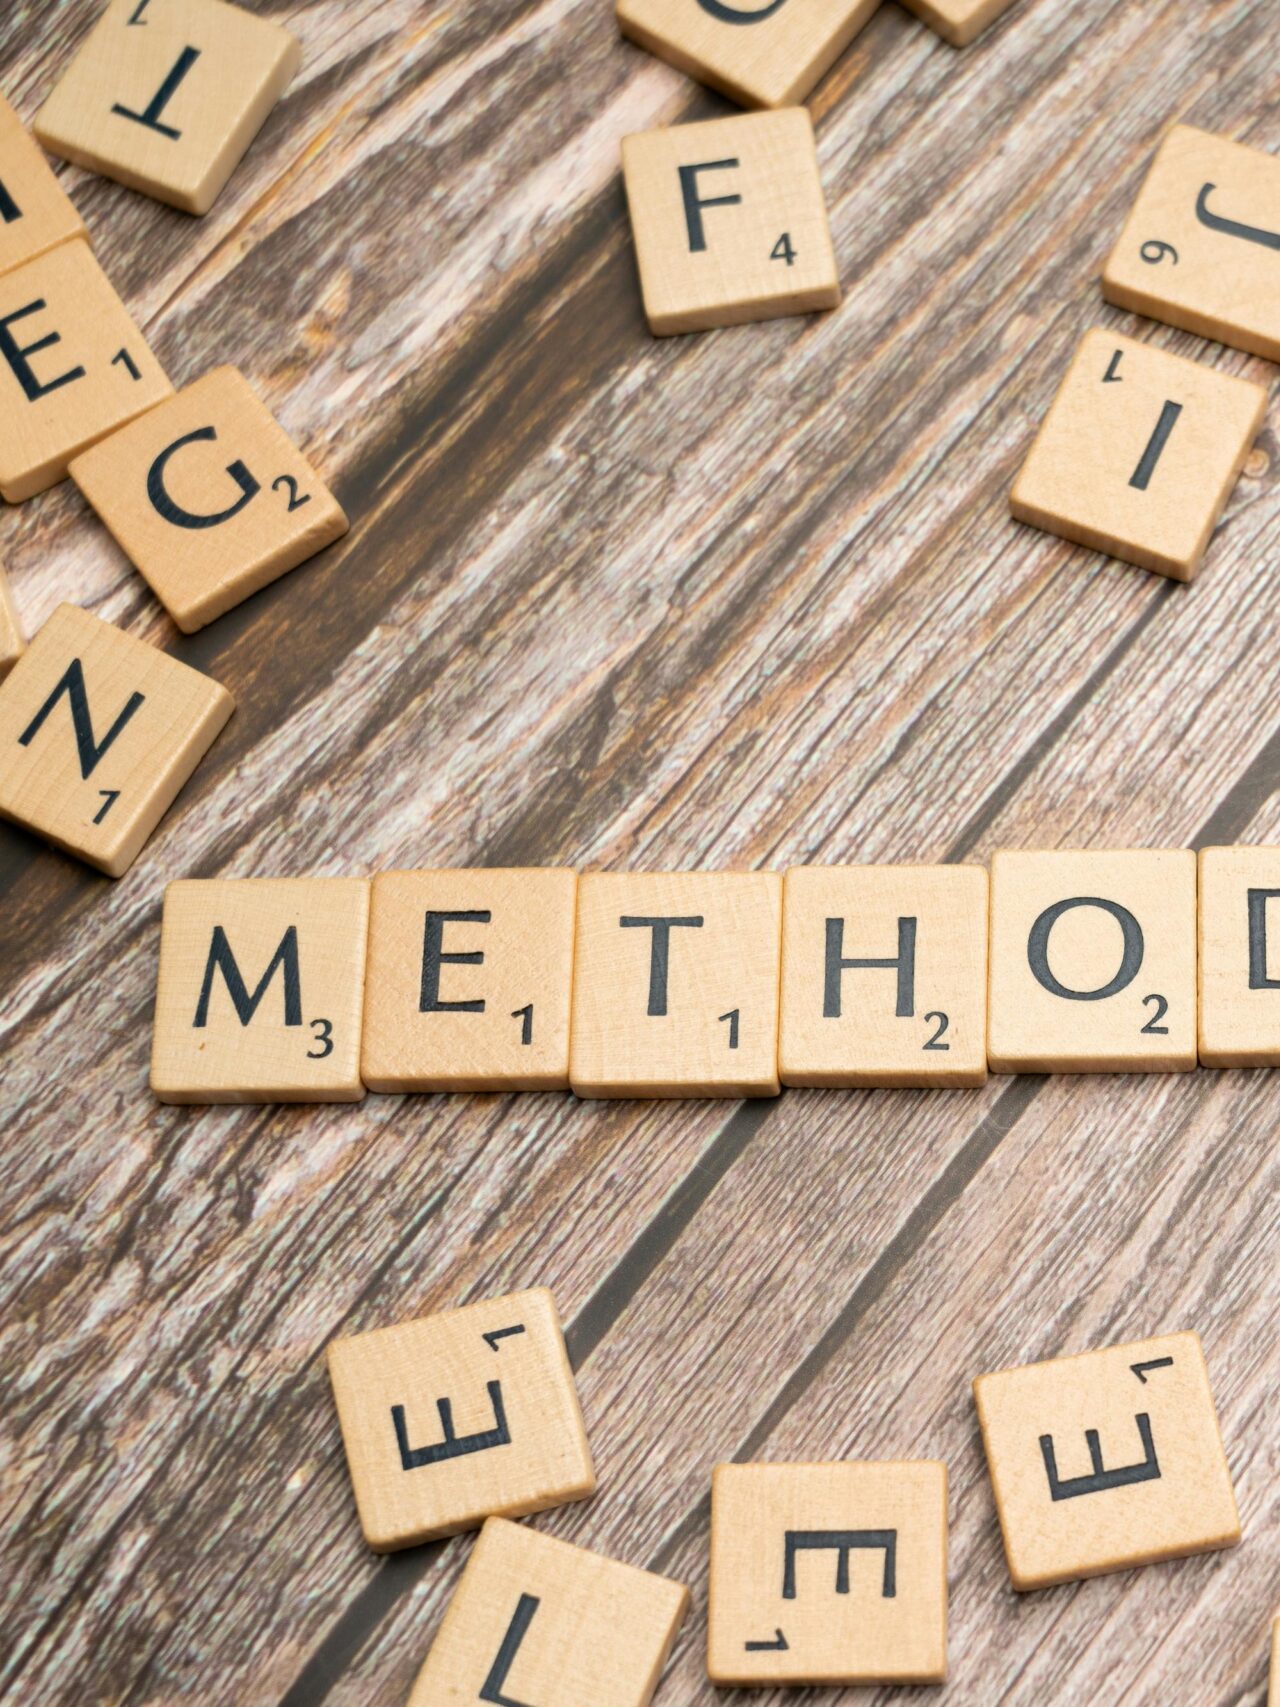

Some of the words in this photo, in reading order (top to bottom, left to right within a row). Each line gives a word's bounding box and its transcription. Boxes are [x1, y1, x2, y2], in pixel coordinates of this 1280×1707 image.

[112, 46, 200, 140] T
[678, 158, 741, 252] F
[770, 233, 796, 265] 4
[1140, 241, 1178, 264] 6
[0, 299, 85, 401] E
[112, 349, 141, 380] 1
[1103, 350, 1123, 382] 1
[147, 426, 260, 529] G
[272, 475, 310, 512] 2
[1129, 400, 1182, 490] I
[18, 658, 145, 780] N
[93, 791, 120, 824] 1
[307, 1019, 333, 1058] 3
[511, 1004, 533, 1045] 1
[718, 1009, 739, 1048] 1
[923, 1011, 949, 1050] 2
[1141, 994, 1168, 1034] 2
[391, 1380, 511, 1471] E
[482, 1324, 525, 1351] 1
[1039, 1413, 1161, 1502] E
[1130, 1357, 1173, 1384] 1
[782, 1529, 897, 1599] E
[745, 1629, 789, 1651] 1
